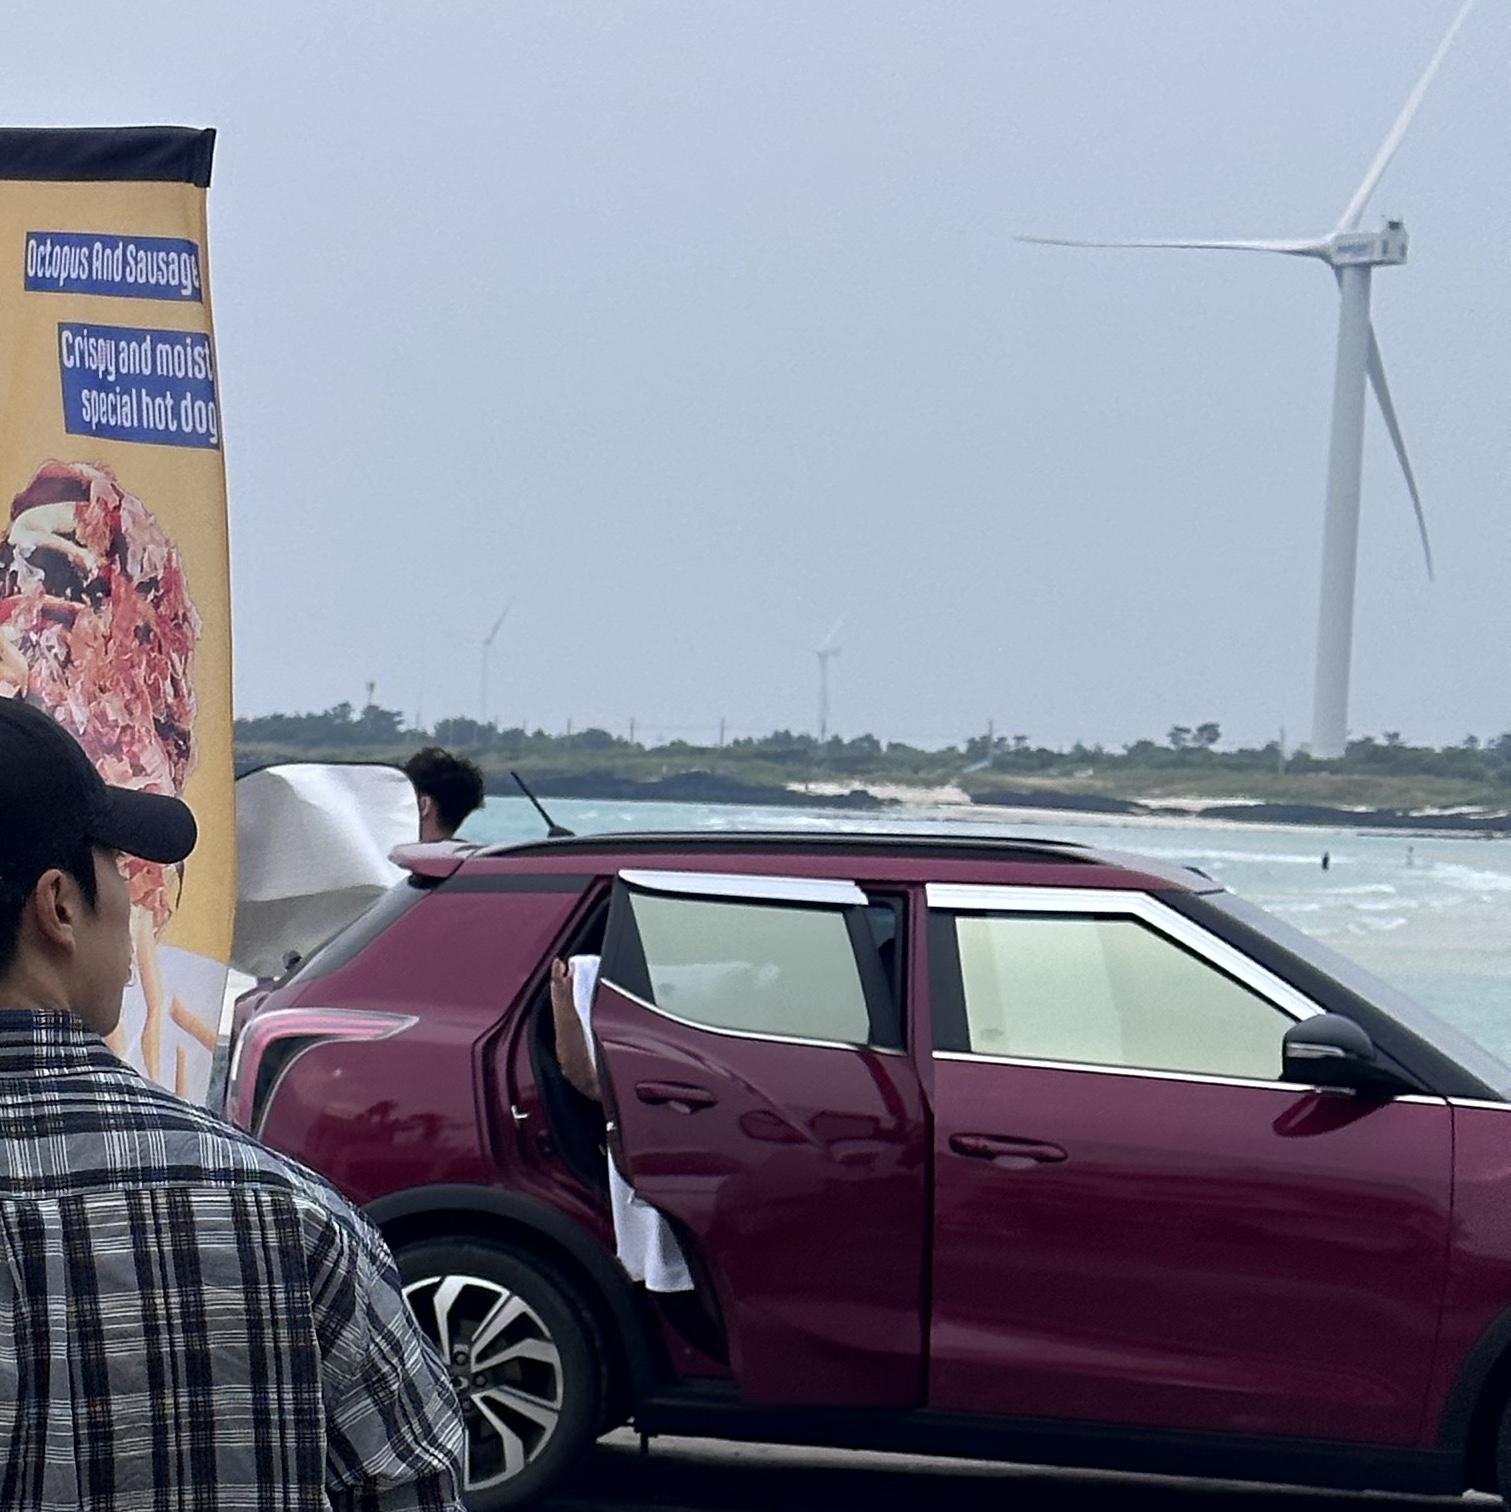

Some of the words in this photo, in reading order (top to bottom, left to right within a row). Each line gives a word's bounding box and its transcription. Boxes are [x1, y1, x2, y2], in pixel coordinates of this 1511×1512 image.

[27, 238, 89, 288] Octopus
[92, 241, 124, 283] And
[61, 329, 116, 382] Crispy
[119, 335, 152, 376] and
[156, 336, 213, 381] moist
[81, 386, 138, 430] special
[141, 388, 178, 432] hot
[180, 391, 218, 444] dog
